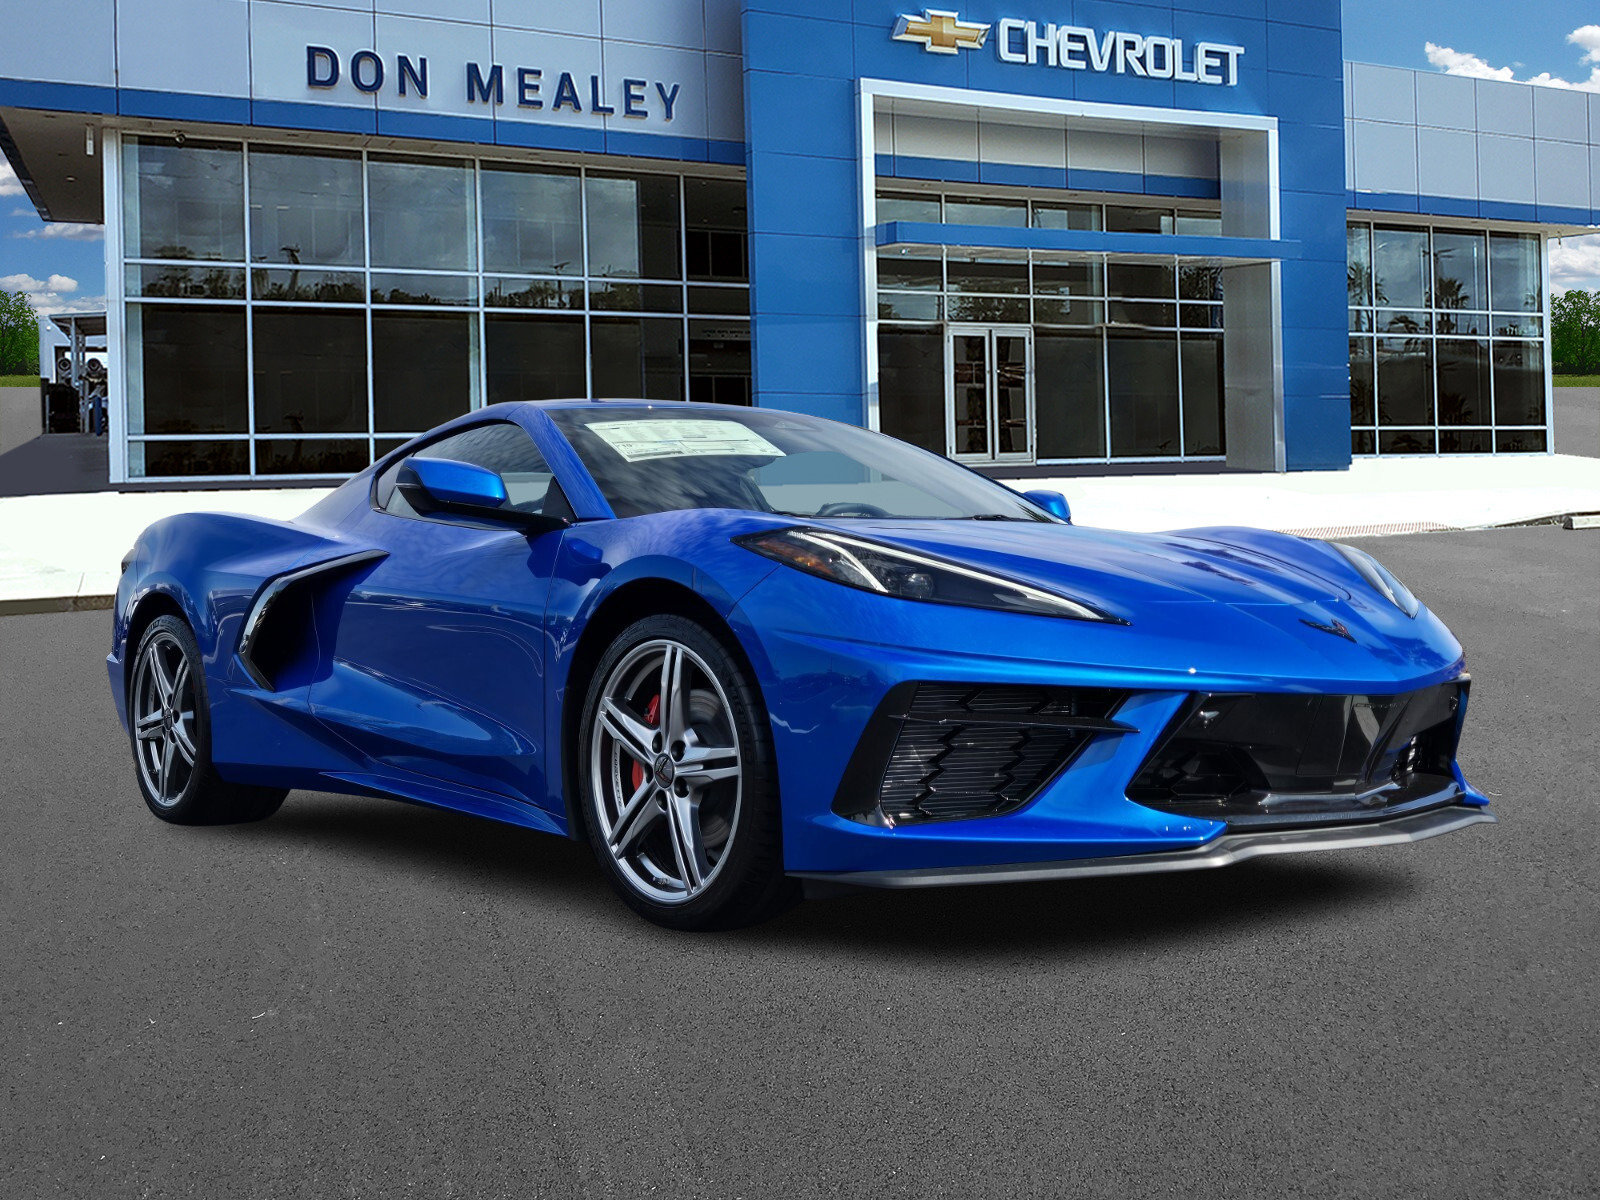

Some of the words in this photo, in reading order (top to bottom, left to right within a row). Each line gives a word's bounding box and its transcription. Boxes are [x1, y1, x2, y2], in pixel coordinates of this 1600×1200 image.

[306, 45, 428, 99] DON
[466, 61, 681, 121] MEALEY
[997, 17, 1245, 86] CHEVROLET
